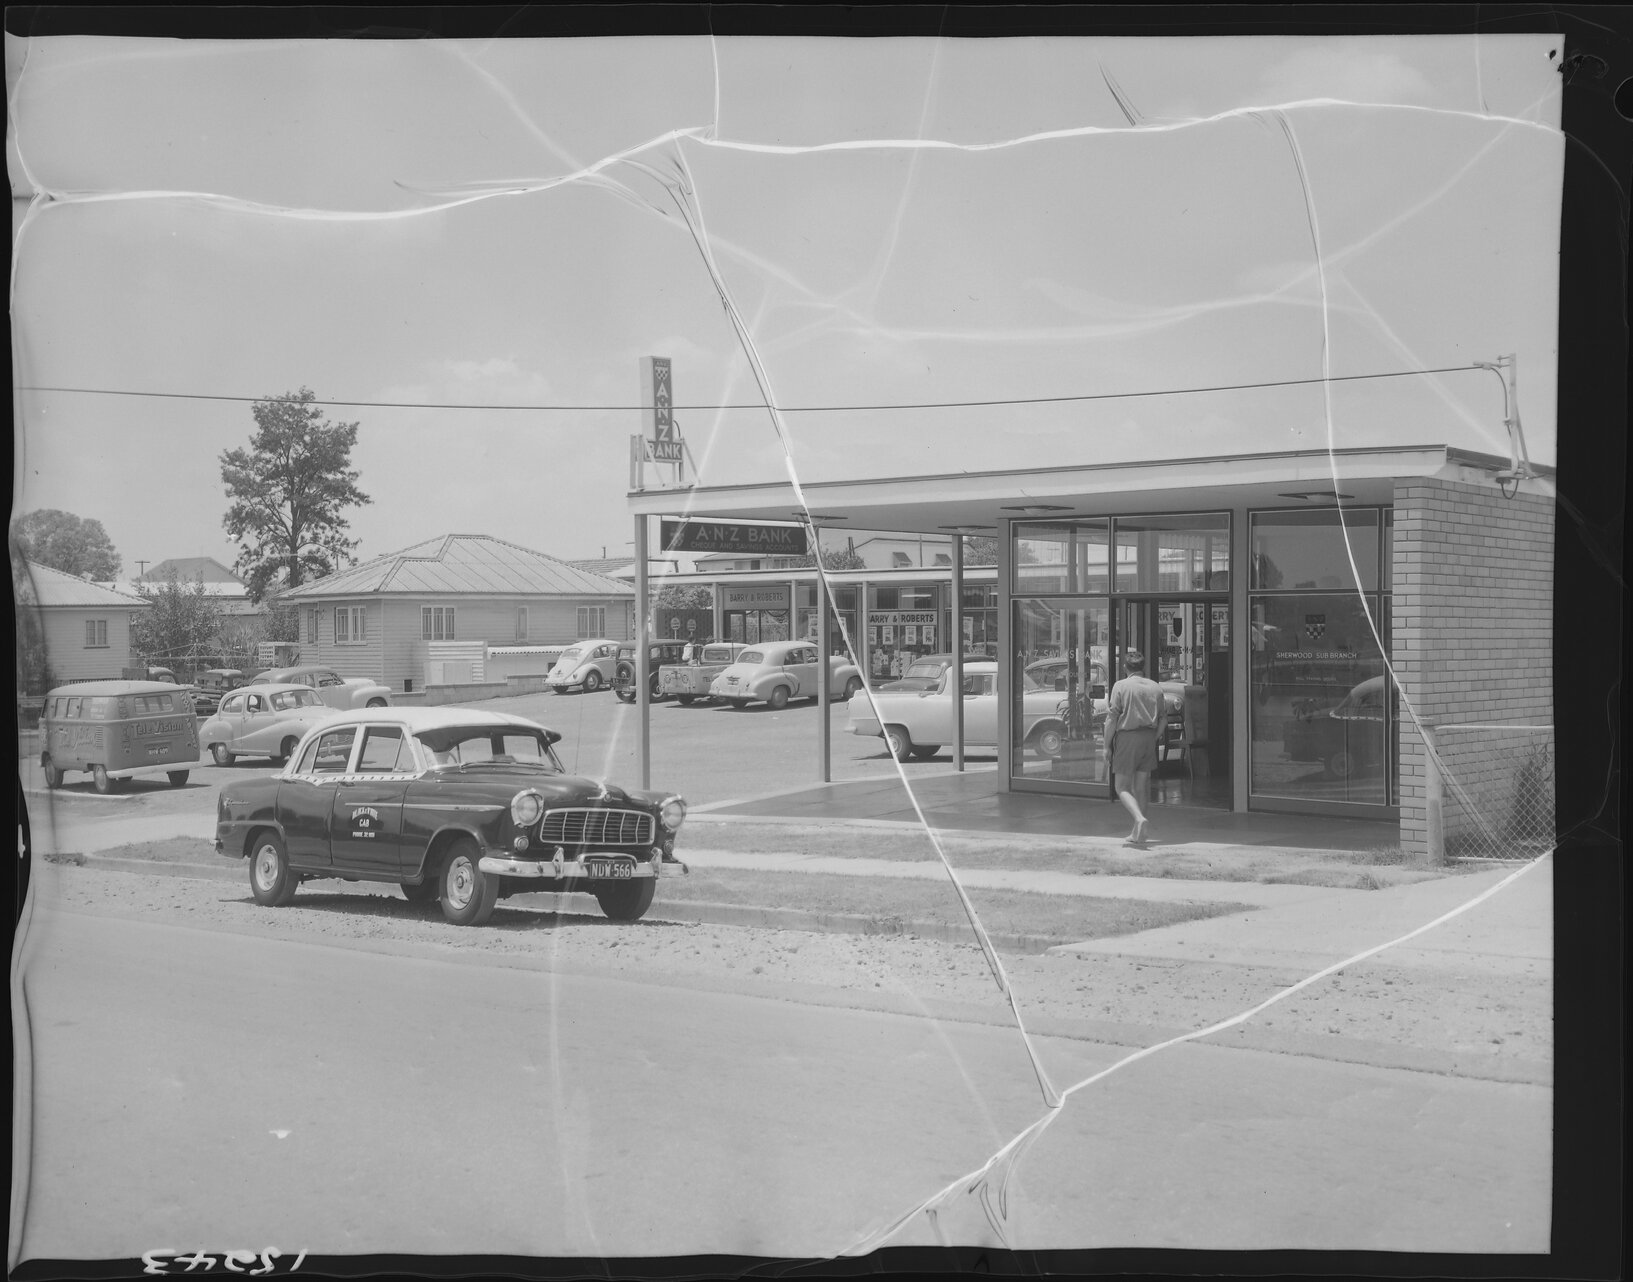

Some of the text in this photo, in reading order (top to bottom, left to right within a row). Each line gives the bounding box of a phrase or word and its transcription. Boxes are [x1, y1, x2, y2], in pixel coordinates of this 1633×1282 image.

[645, 442, 681, 459] BANK
[748, 528, 793, 544] BANK
[729, 593, 748, 602] BARRY
[756, 592, 784, 602] ROBERTS
[869, 614, 934, 623] ARRY & ROBERTS
[359, 818, 370, 827] CAB
